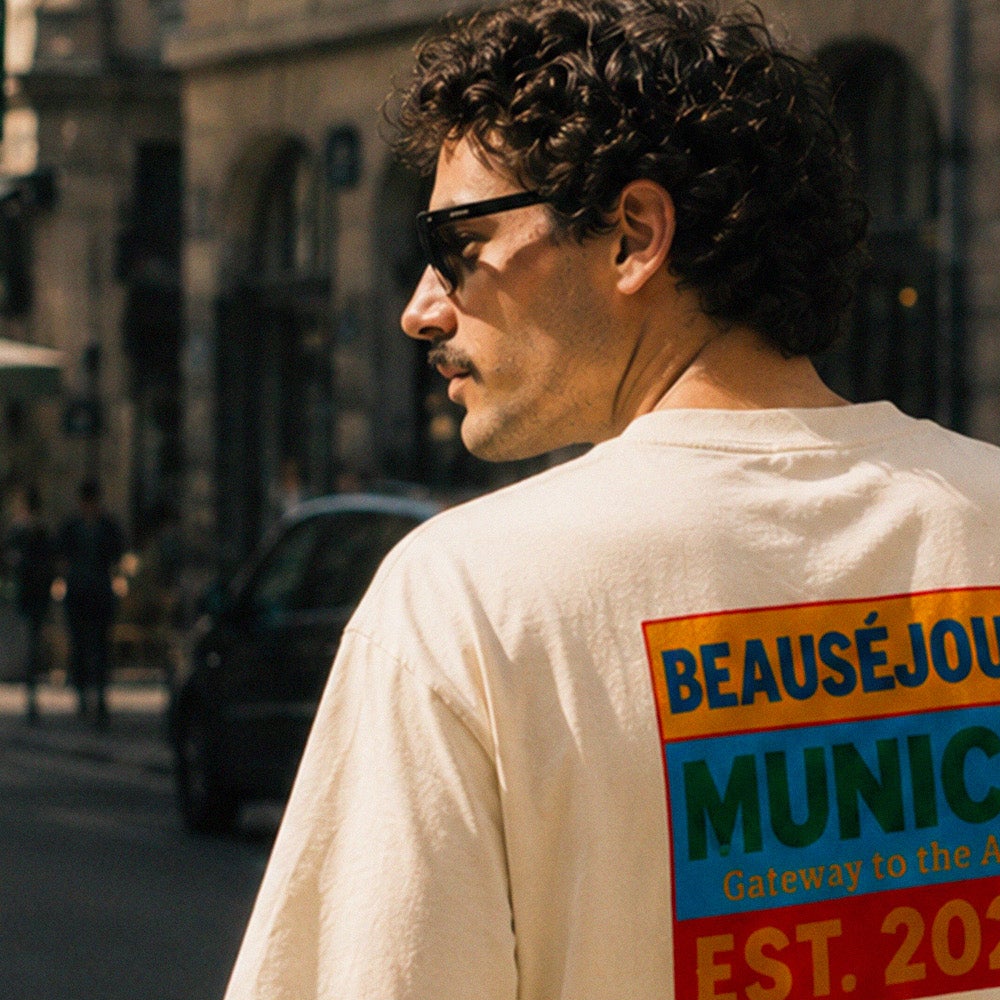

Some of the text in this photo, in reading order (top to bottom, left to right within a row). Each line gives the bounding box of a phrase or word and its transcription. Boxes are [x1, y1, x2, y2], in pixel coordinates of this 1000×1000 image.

[723, 860, 862, 901] Gateway
[872, 853, 908, 881] to
[917, 841, 971, 874] the
